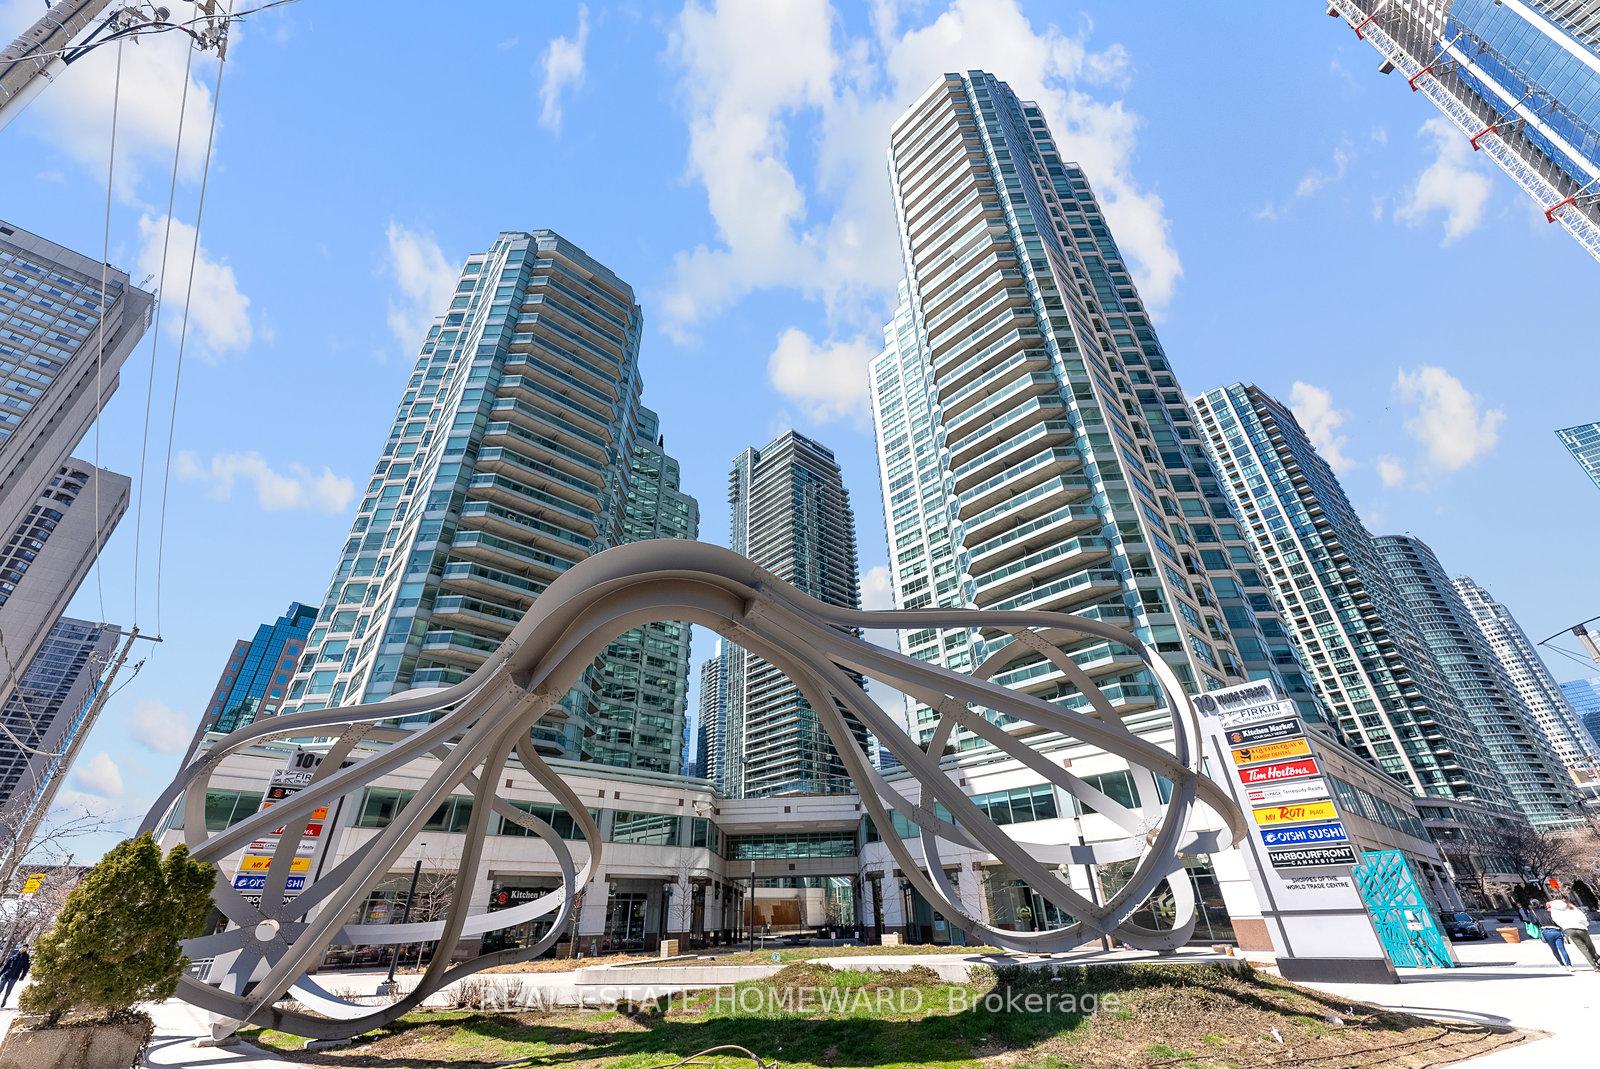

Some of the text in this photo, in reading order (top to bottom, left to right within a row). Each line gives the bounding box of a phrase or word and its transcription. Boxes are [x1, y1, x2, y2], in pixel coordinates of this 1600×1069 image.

[1193, 694, 1217, 714] 10
[1240, 704, 1280, 718] FIRKIN
[1242, 722, 1295, 737] Kitchen Market
[296, 752, 315, 769] 10
[1246, 769, 1267, 781] Tim
[1280, 806, 1306, 820] ROTI
[1278, 827, 1345, 842] OYSHI SUSHI
[1271, 848, 1352, 861] HARBOURFRONT
[249, 879, 304, 888] OYS SHI
[1286, 883, 1307, 891] WORLD
[510, 890, 539, 899] Kitchen
